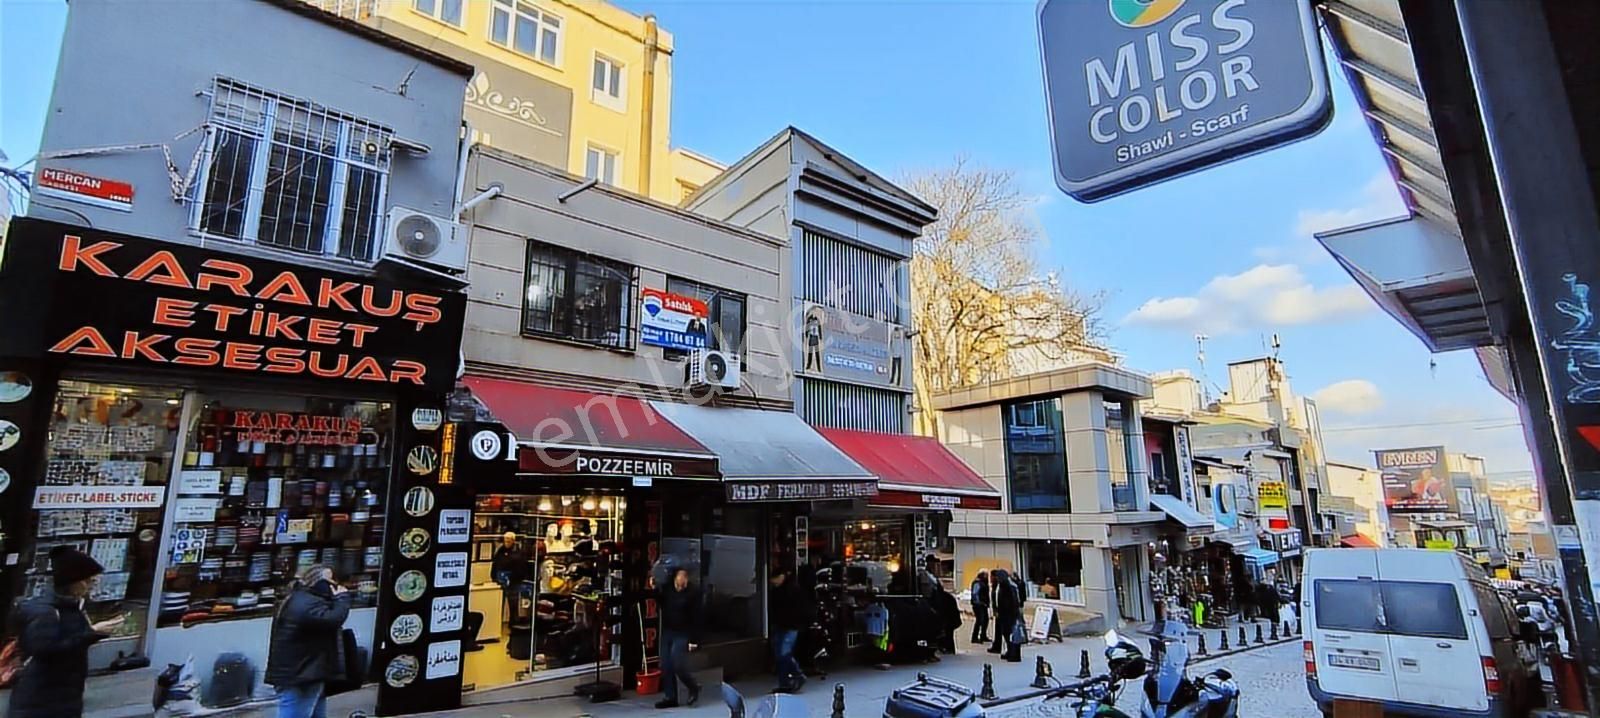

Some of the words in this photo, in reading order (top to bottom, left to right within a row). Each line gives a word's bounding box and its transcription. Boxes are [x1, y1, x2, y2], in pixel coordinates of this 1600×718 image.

[1084, 0, 1255, 106] MISS
[1088, 55, 1260, 143] COLOR
[1115, 132, 1174, 162] Shawl
[1190, 104, 1250, 137] Scarf
[44, 169, 102, 190] MERCAN
[58, 234, 443, 331] KARAKUŞ
[153, 297, 380, 348] ETİKET
[48, 325, 427, 385] AKSESUAR
[576, 457, 673, 476] POZZEEMİR
[731, 483, 771, 500] MDF
